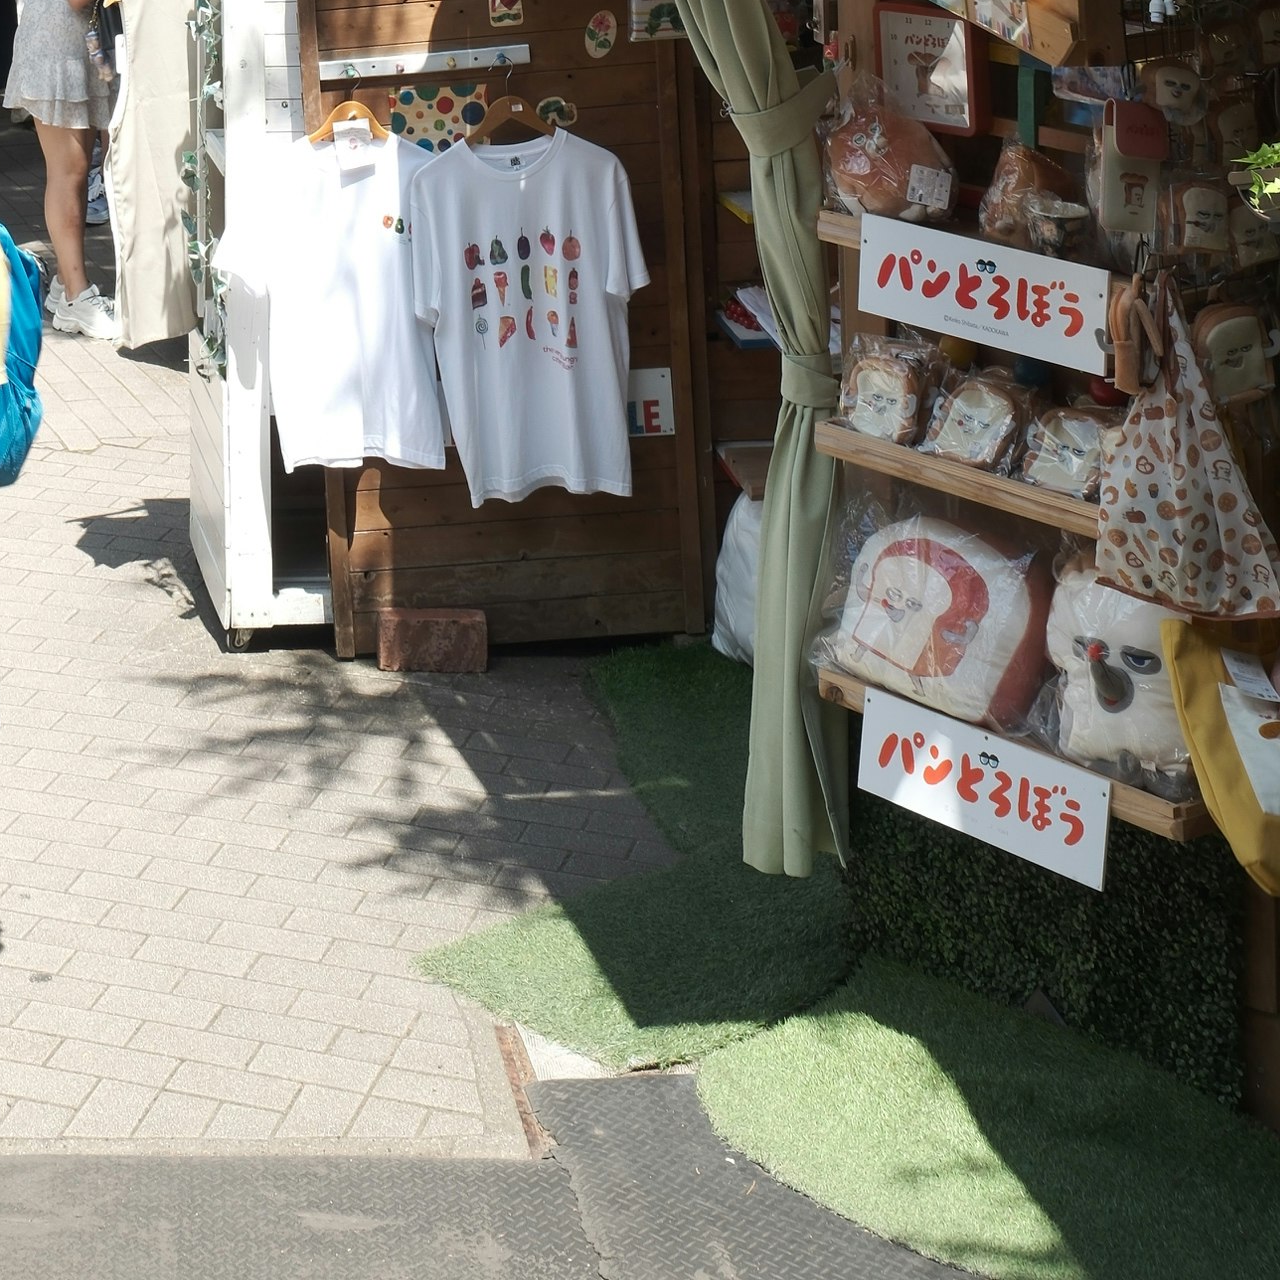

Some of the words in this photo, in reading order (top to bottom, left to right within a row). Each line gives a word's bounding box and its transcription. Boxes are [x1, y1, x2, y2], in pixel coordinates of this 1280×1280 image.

[904, 33, 949, 48] パンどろぼ
[876, 248, 1085, 338] パンどろぼう
[878, 731, 1085, 846] パンどろぼう
